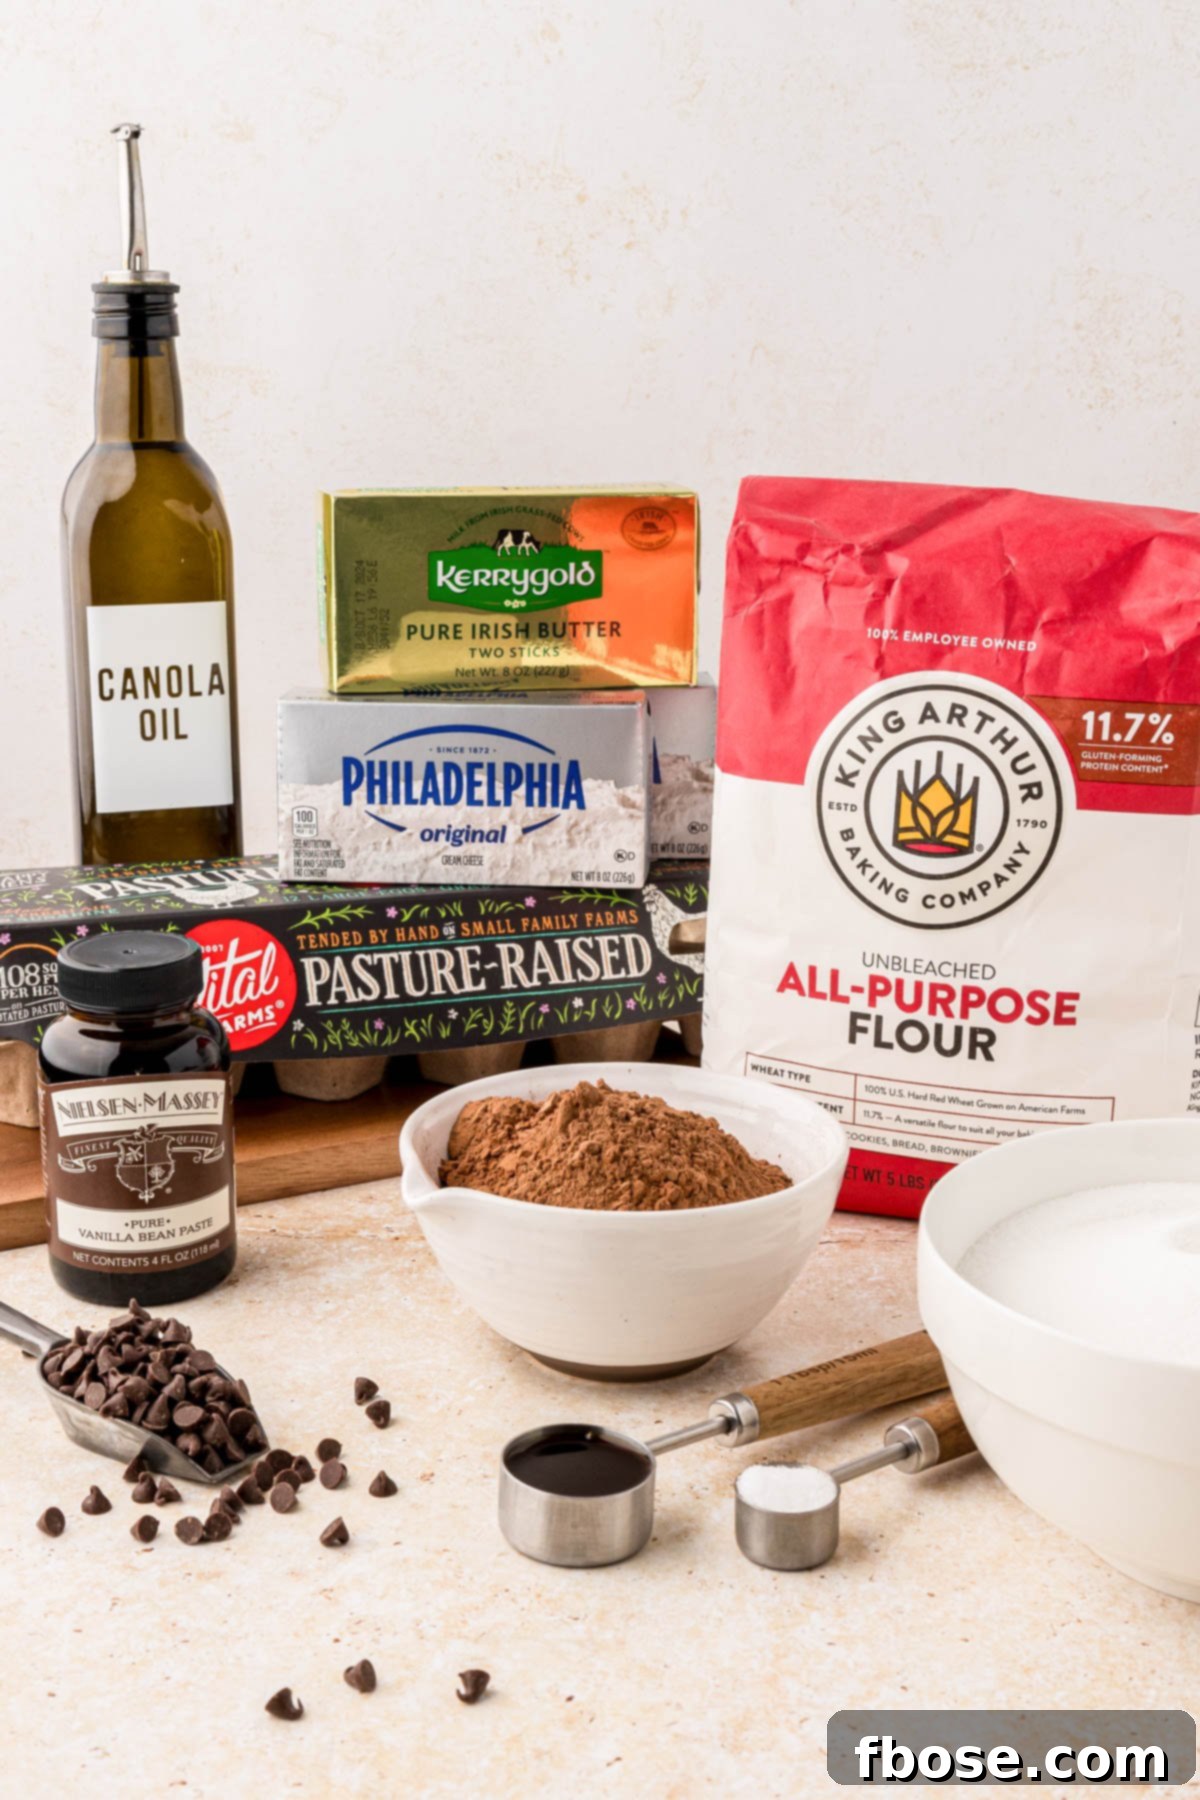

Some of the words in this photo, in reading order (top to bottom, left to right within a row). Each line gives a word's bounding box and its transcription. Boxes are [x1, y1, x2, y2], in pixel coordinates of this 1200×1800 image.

[406, 623, 463, 640] PURE
[471, 622, 530, 640] IRISH
[538, 621, 622, 639] BUTTER
[866, 627, 899, 641] 100%
[903, 630, 978, 648] EMPLOYEE
[982, 637, 1037, 652] OWNED
[469, 647, 504, 659] TWO
[509, 646, 560, 658] STICKS
[98, 662, 225, 702] CANOLA
[455, 667, 477, 678] Net
[502, 666, 510, 677] 8
[139, 707, 188, 742] OIL
[1082, 710, 1174, 744] 11.7%
[436, 746, 465, 755] SINCE
[834, 709, 907, 789] KING
[918, 701, 1044, 804] ARTHUR
[1081, 751, 1162, 763] GLUTEN-FORMING
[1080, 761, 1119, 771] PROTEIN
[342, 756, 586, 811] PHILADELPHIA
[296, 810, 313, 823] 100
[828, 801, 858, 813] ESTD
[420, 824, 506, 847] original
[1016, 818, 1048, 830] 1790
[571, 871, 583, 881] NET
[585, 871, 595, 881] WT
[602, 871, 611, 881] OZ
[839, 828, 911, 903] BAKING
[922, 841, 1031, 910] COMPANY
[296, 930, 363, 950] TENDED
[369, 928, 389, 945] BY
[396, 925, 440, 942] HAND
[461, 919, 516, 938] SMALL
[521, 913, 578, 932] FAMILY
[586, 909, 639, 928] FARMS
[0, 962, 41, 988] 108
[300, 933, 652, 1007] PASTURE-RAISED
[862, 951, 996, 981] UNBLEACHED
[1, 987, 29, 1000] PER
[776, 961, 1080, 1027] ALL-PURPOSE
[0, 1009, 29, 1021] OTATED
[31, 1001, 69, 1017] PASTUR
[221, 1004, 276, 1034] ARMS
[847, 1011, 997, 1062] FLOUR
[750, 1063, 785, 1078] WHEAT
[788, 1071, 811, 1083] TYPE
[864, 1084, 886, 1095] 100%
[889, 1088, 905, 1098] U.S.
[908, 1091, 928, 1102] Hard
[930, 1093, 946, 1103] Red
[948, 1095, 975, 1107] Wheat
[977, 1099, 1004, 1110] Grown
[1018, 1104, 1058, 1115] American
[1060, 1106, 1085, 1116] Farms
[863, 1109, 883, 1121] 11.7%
[903, 1117, 936, 1129] versatile
[937, 1120, 957, 1131] flour
[958, 1124, 967, 1132] to
[969, 1124, 983, 1134] suit
[985, 1126, 995, 1135] all
[996, 1130, 1015, 1138] your
[892, 1139, 928, 1153] BREAD,
[930, 1144, 982, 1160] BROWNIE
[844, 1164, 858, 1180] ET
[863, 1167, 882, 1184] WT
[887, 1171, 895, 1186] 5
[900, 1173, 925, 1190] LBS
[78, 1228, 135, 1243] VANILLA
[138, 1228, 176, 1243] BEAN
[179, 1217, 213, 1237] PASTE
[73, 1251, 89, 1263] NET
[92, 1253, 149, 1267] CONTENTS
[152, 1256, 158, 1266] 4
[161, 1253, 173, 1265] FL
[175, 1252, 189, 1263] OZ
